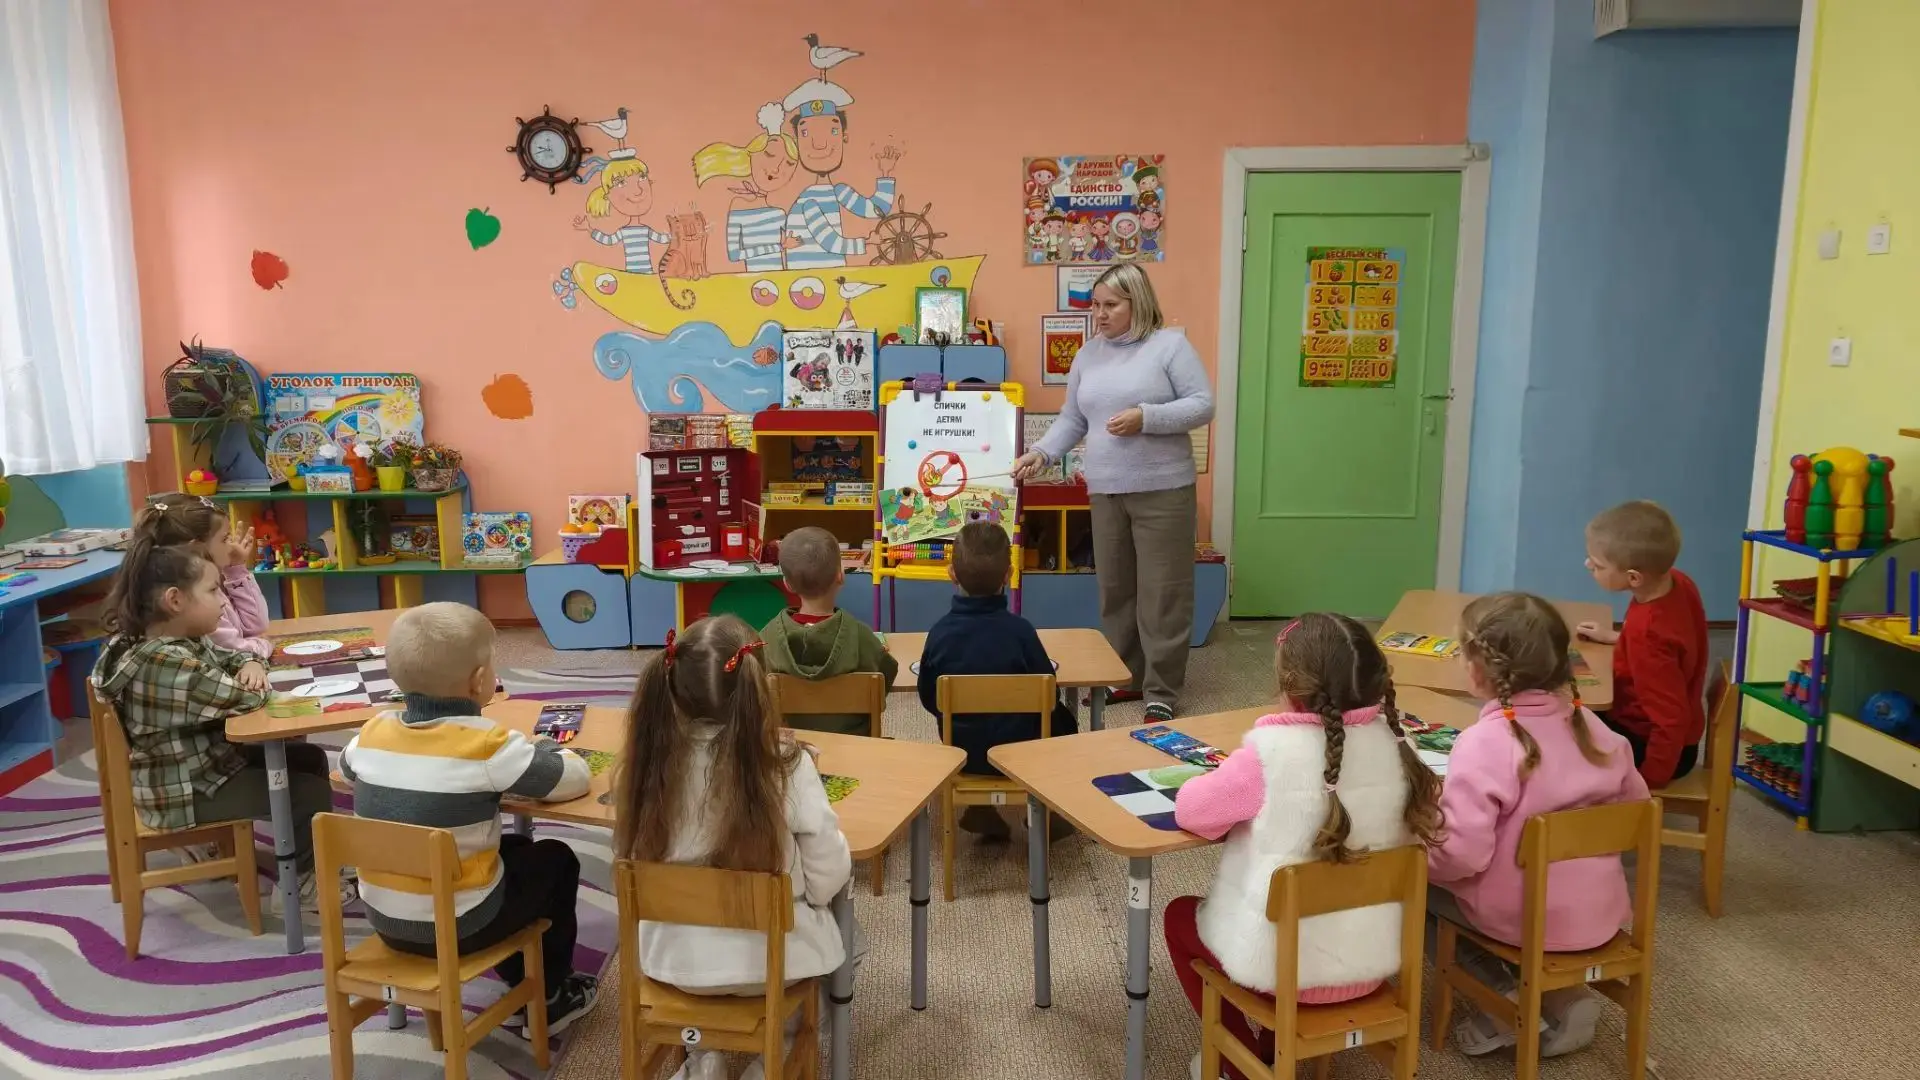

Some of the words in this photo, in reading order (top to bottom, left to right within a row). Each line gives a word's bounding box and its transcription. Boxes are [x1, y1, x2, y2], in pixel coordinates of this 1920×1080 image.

[1077, 161, 1082, 169] В
[1083, 161, 1113, 169] ДРУЖБЕ
[1070, 184, 1123, 193] ЕДИНСТВО
[1070, 196, 1123, 206] РОССИИ!
[1317, 264, 1323, 279] 1
[1384, 264, 1394, 280] 2
[1314, 289, 1324, 304] 3
[1382, 290, 1392, 305] 4
[1312, 313, 1321, 327] 5
[1380, 313, 1390, 328] 6
[1311, 336, 1320, 351] 7
[1378, 337, 1388, 352] 8
[1309, 362, 1318, 376] 9
[1371, 363, 1388, 377] 10
[270, 377, 334, 387] УГОЛОК
[342, 377, 415, 387] ПРИРОДЫ
[934, 402, 966, 410] СПИЧКИ
[936, 415, 962, 424] ДЕТЯМ
[923, 428, 933, 436] НЕ
[934, 428, 975, 437] ИГРУШКИ!
[274, 771, 284, 786] 2
[1131, 887, 1140, 903] 2
[1591, 966, 1597, 980] 1
[387, 986, 393, 999] 1
[686, 1029, 697, 1042] 2
[1351, 1032, 1358, 1046] 1
